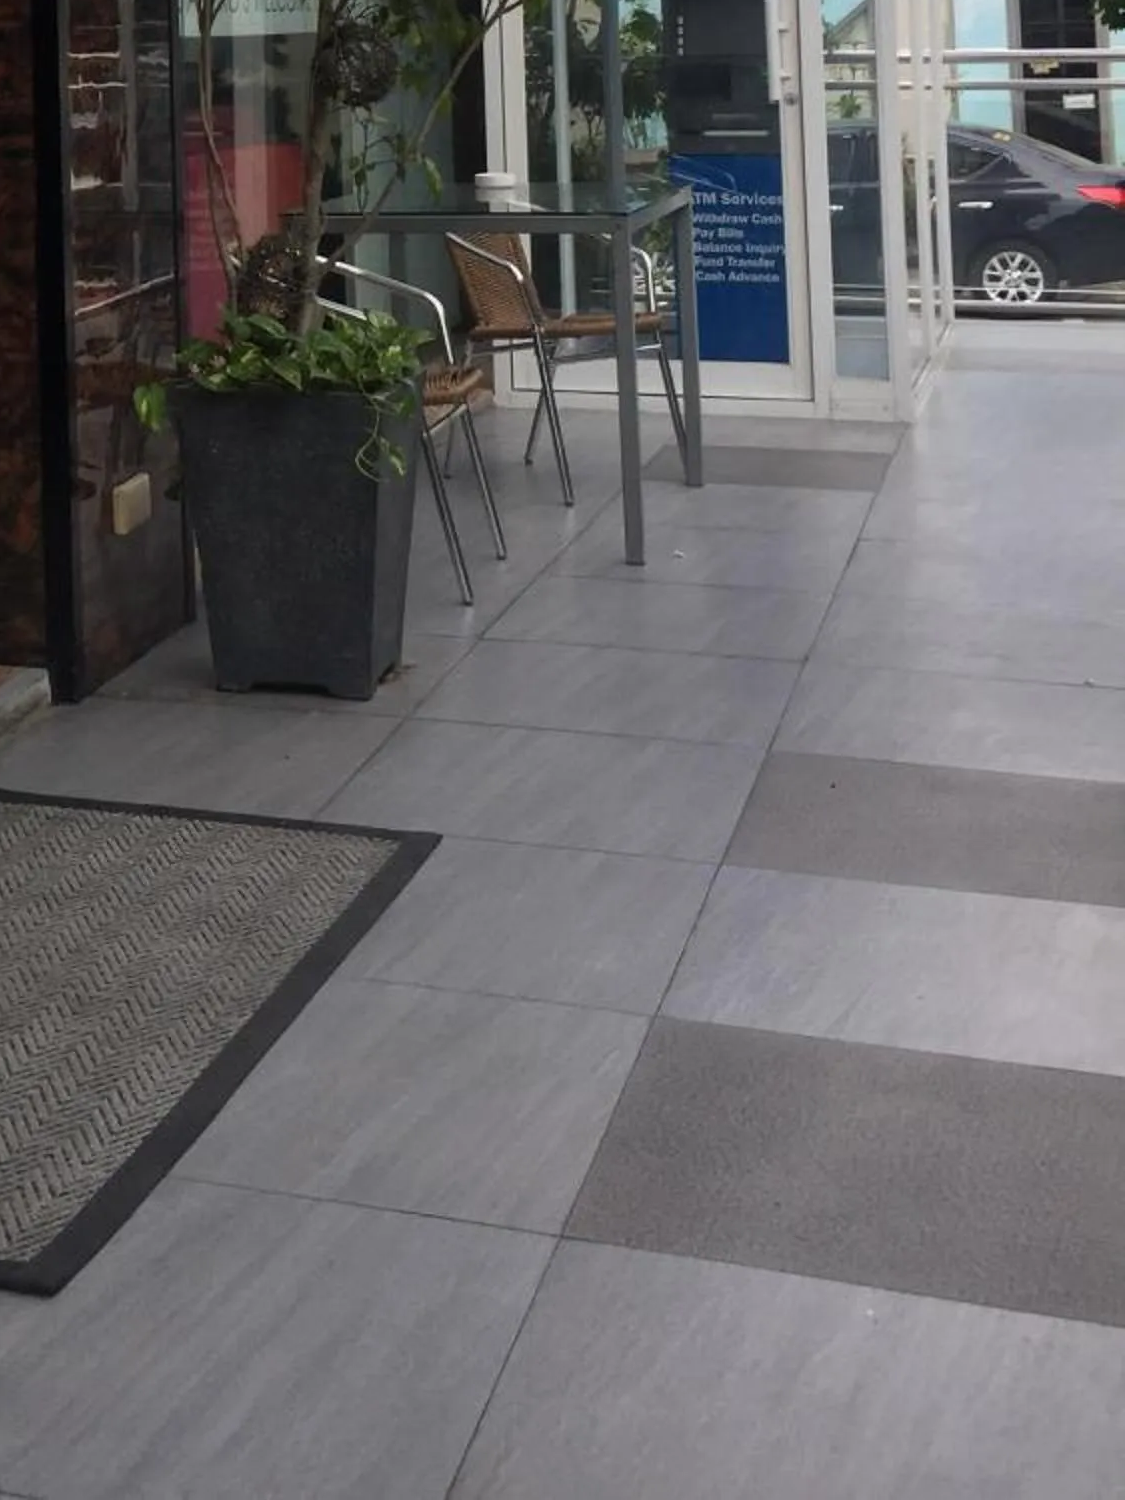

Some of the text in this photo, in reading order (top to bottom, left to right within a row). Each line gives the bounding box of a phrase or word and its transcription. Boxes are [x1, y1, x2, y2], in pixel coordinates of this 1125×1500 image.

[691, 191, 717, 205] TM
[692, 212, 782, 225] Withdraw Cash
[692, 227, 714, 241] Pay
[693, 241, 743, 254] Balance
[695, 255, 776, 268] Fund Transfer
[695, 270, 780, 283] Cash Advance
